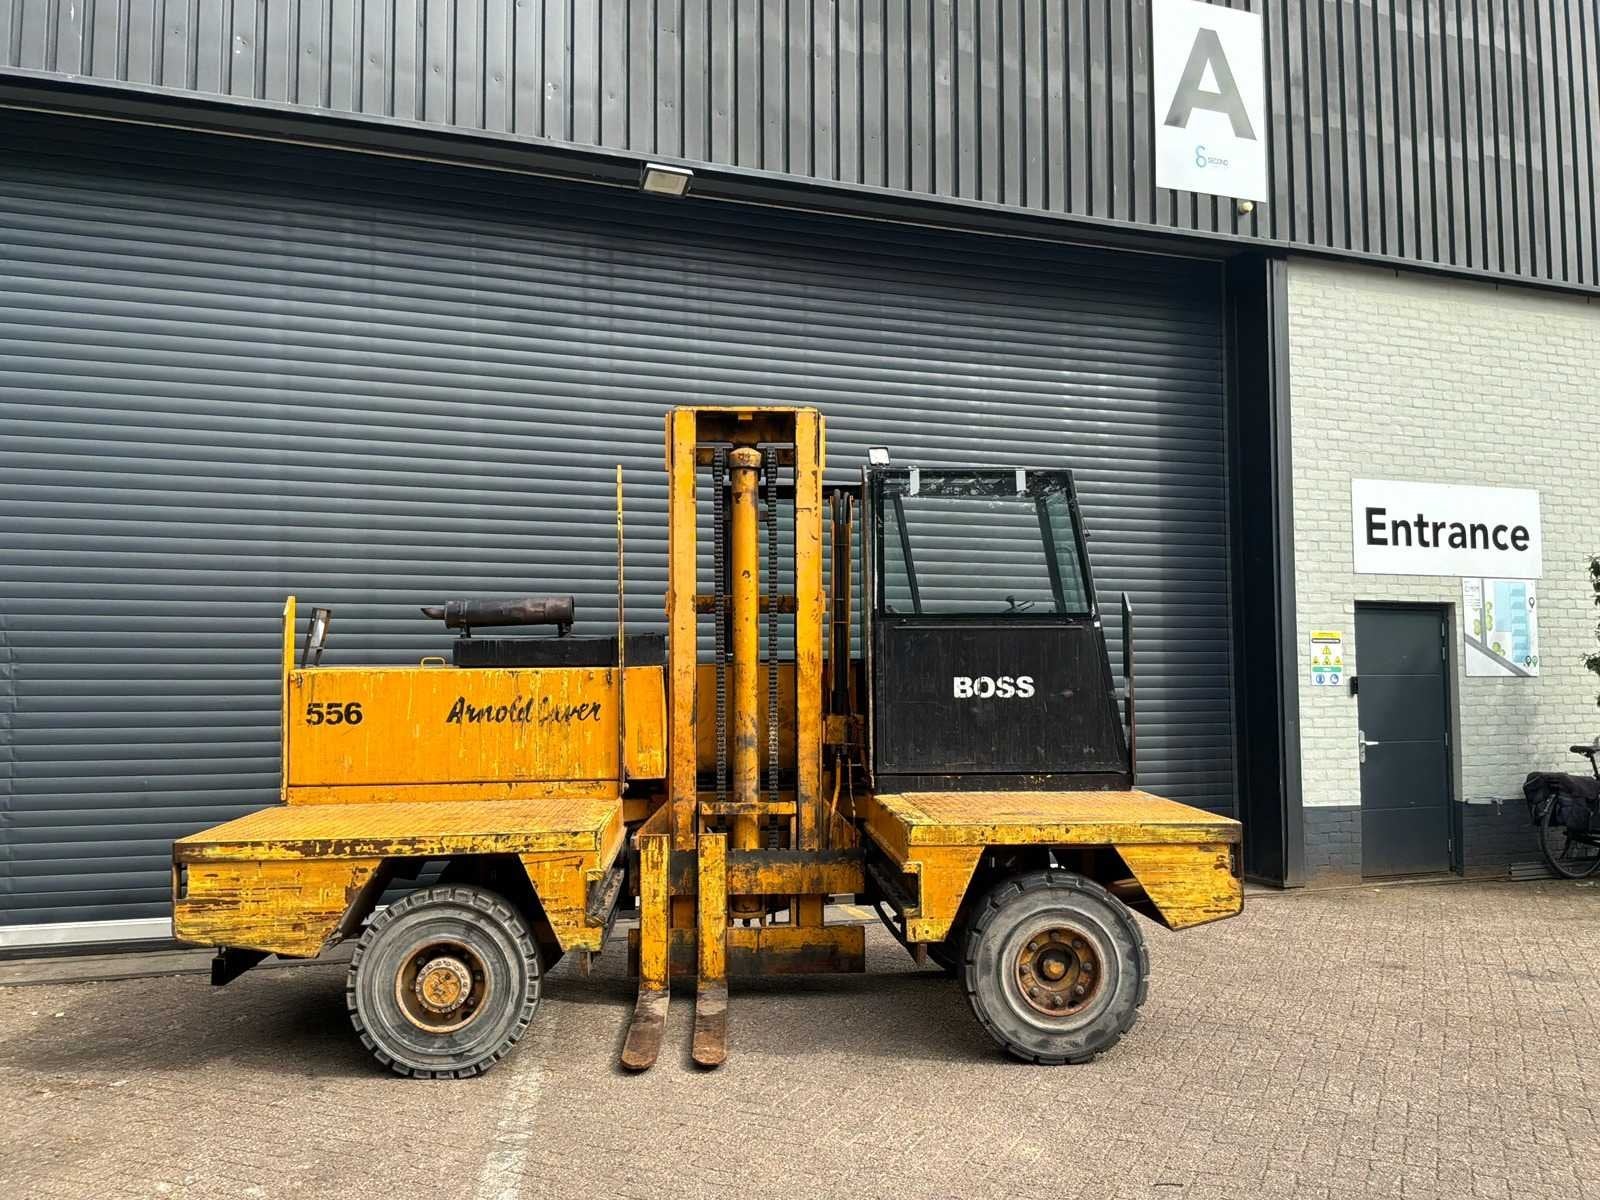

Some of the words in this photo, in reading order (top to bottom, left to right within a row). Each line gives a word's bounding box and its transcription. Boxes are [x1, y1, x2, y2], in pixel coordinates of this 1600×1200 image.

[1163, 27, 1257, 141] A
[1365, 506, 1530, 551] Entrance
[953, 676, 1035, 698] BOSS
[305, 702, 363, 725] 556
[446, 695, 533, 723] Arnold
